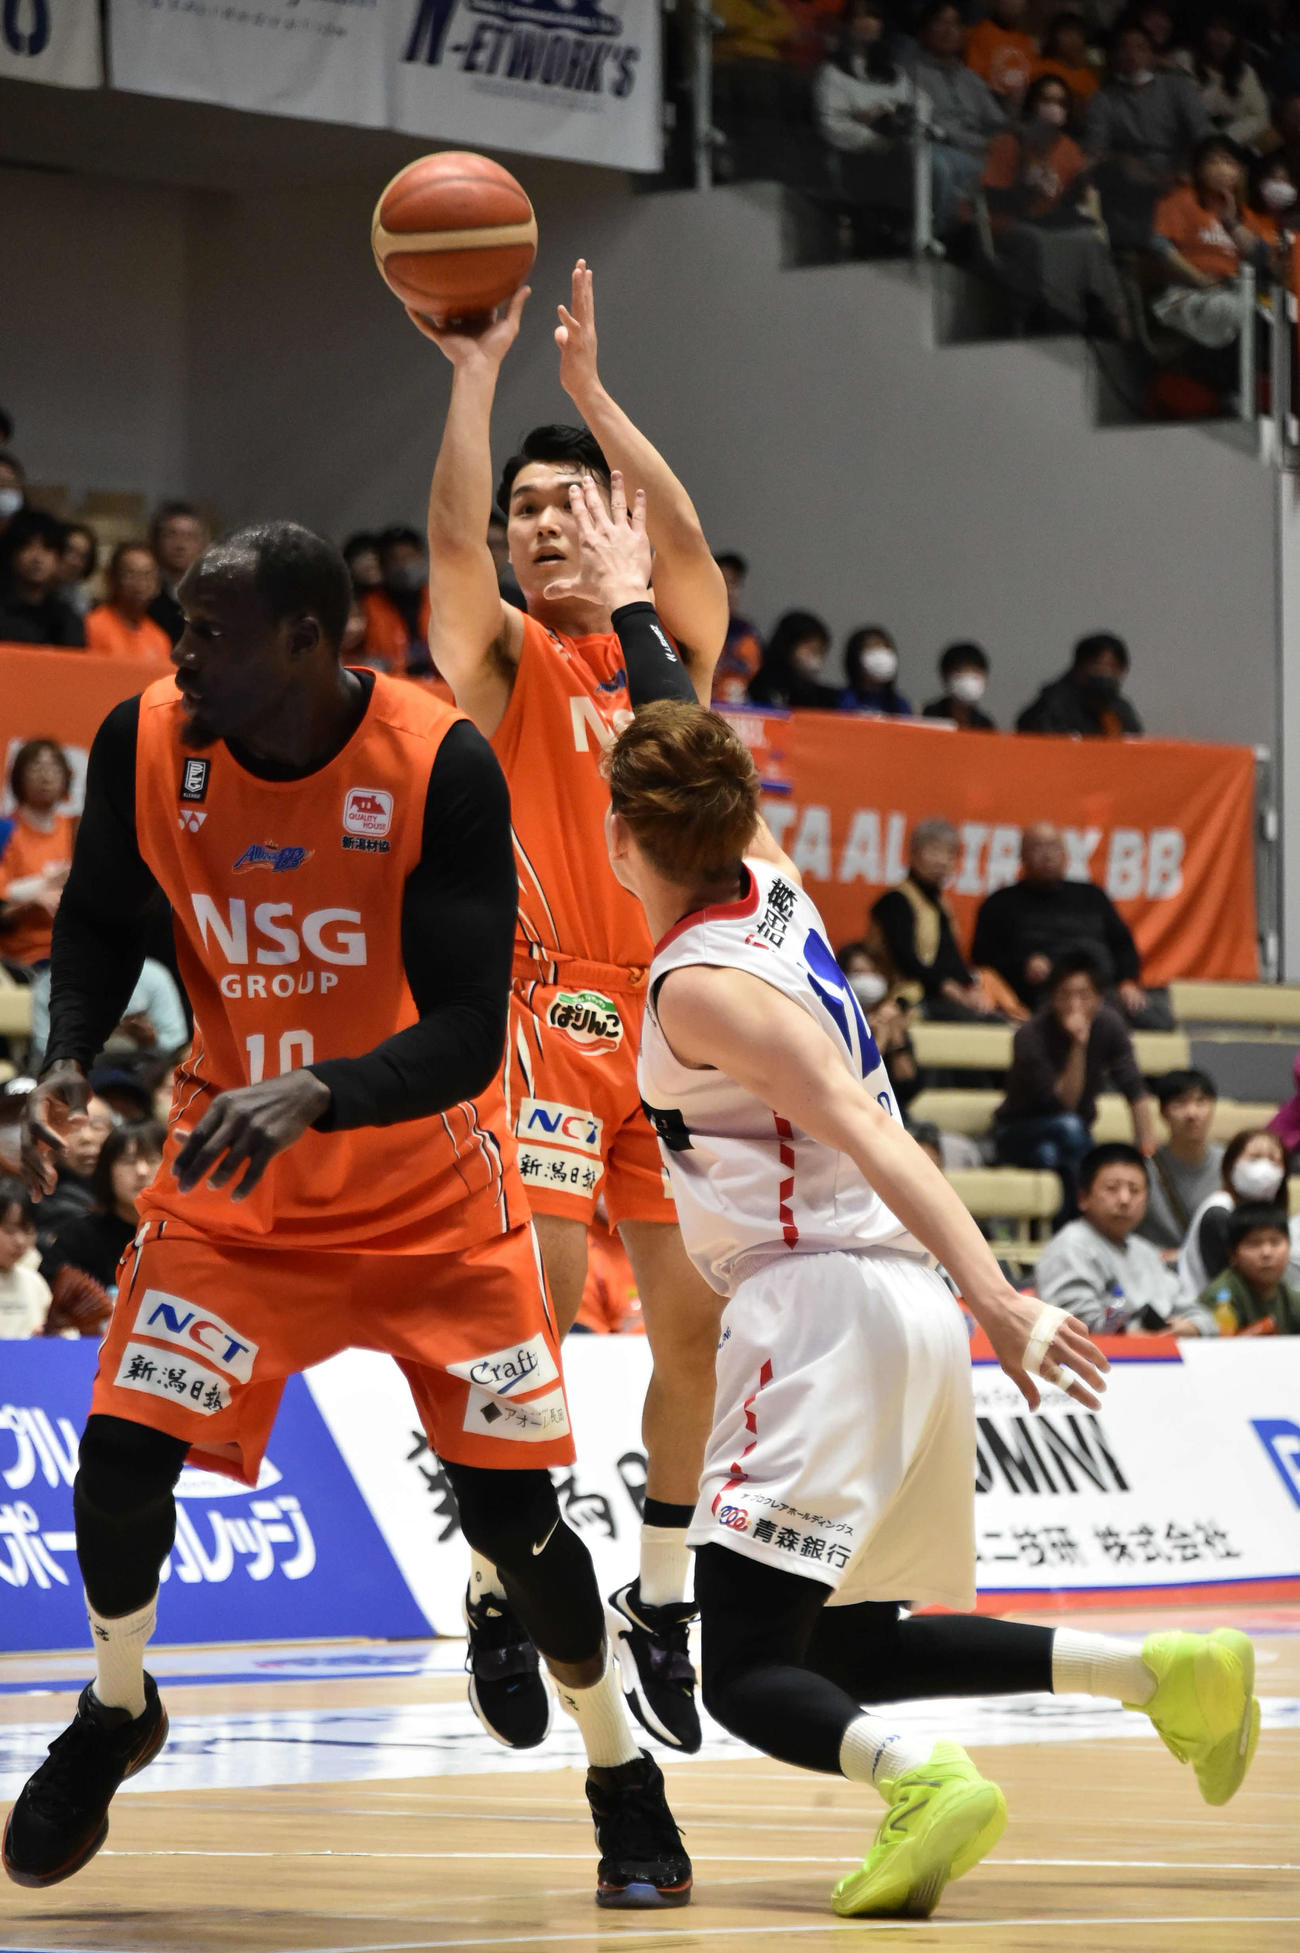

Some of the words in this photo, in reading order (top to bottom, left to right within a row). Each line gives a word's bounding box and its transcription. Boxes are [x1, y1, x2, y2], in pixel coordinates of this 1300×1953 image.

[349, 812, 377, 823] QUALITY
[839, 806, 1104, 896] ALIRX
[1106, 827, 1186, 901] BB
[191, 893, 368, 967] NSG
[220, 971, 339, 999] GROUP
[550, 1002, 621, 1038] ぱりんこ
[147, 1302, 249, 1364] NCT
[752, 1517, 852, 1569] 青森銀行
